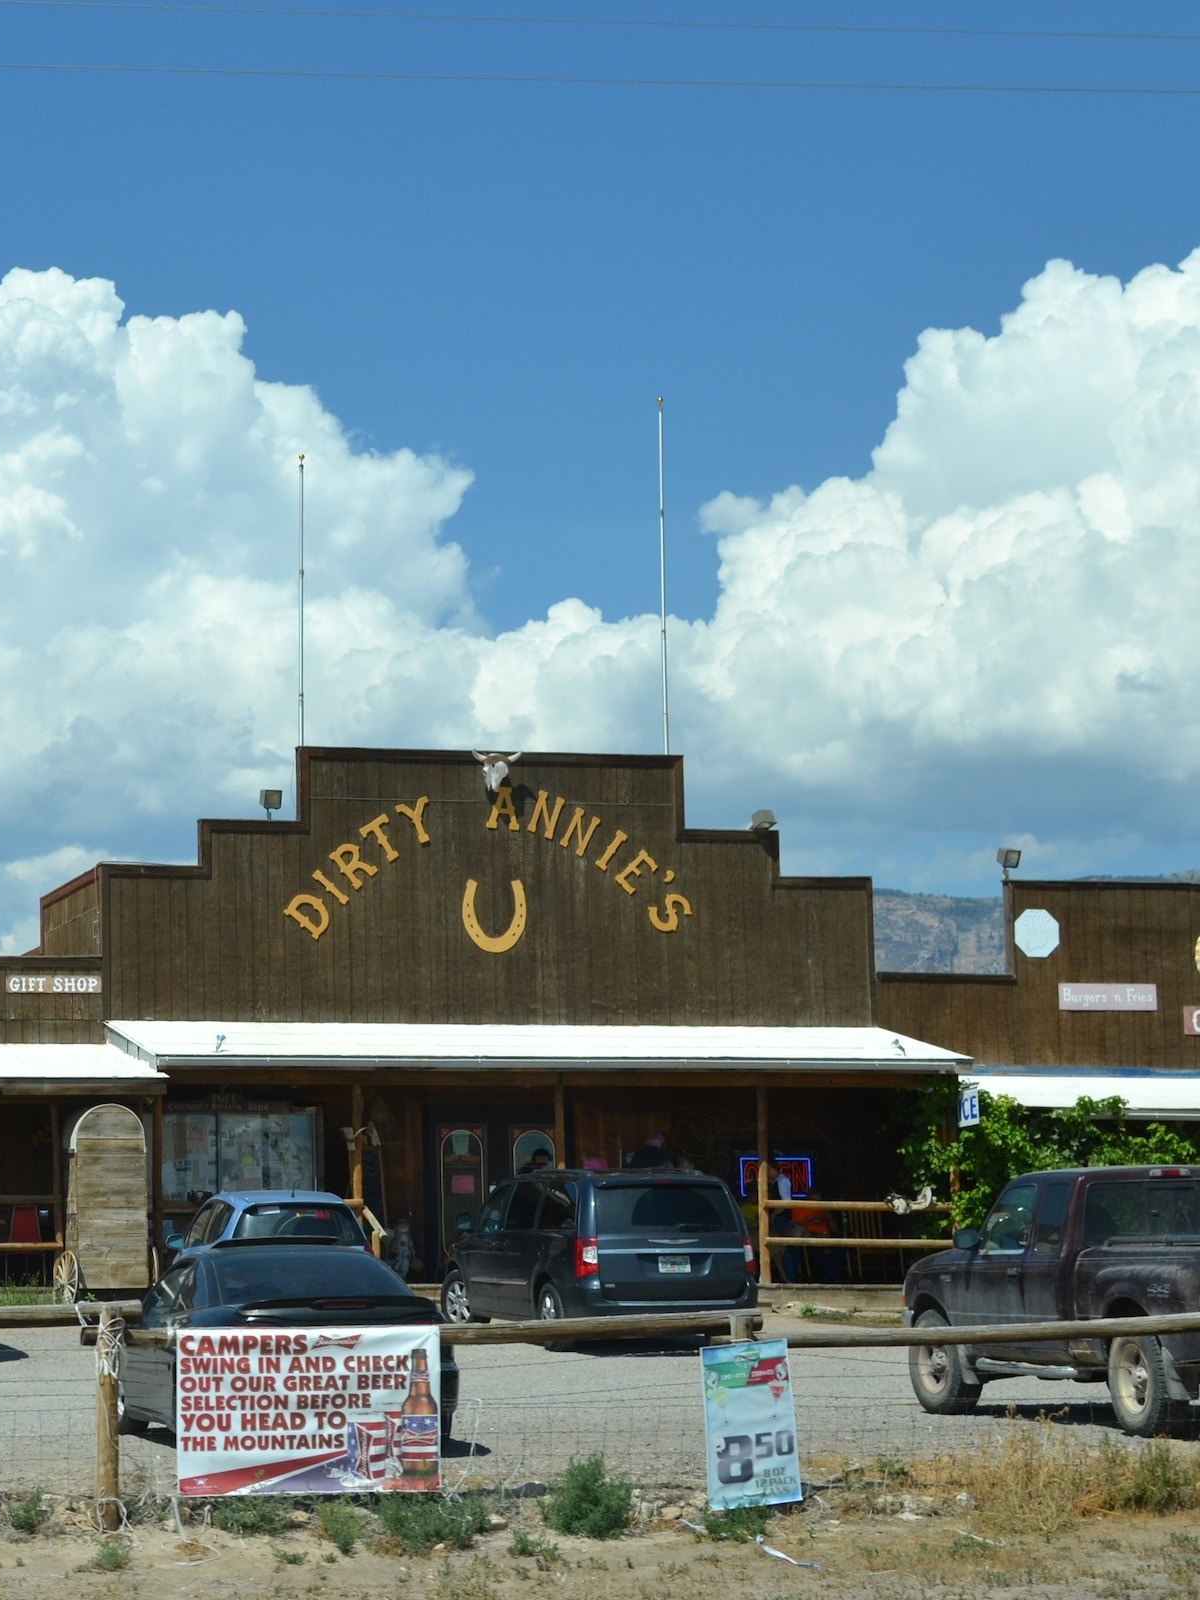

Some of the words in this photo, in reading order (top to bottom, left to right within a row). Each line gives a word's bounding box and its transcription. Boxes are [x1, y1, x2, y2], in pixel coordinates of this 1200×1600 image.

[284, 796, 430, 940] DIRTY
[486, 787, 693, 932] ANNIE'S
[9, 977, 46, 992] GIFT
[52, 977, 98, 992] SHOP
[1063, 988, 1107, 1007] Burgers
[1126, 988, 1152, 1003] Fries
[180, 1335, 308, 1356] CAMPERS
[180, 1357, 250, 1374] SWING
[258, 1356, 281, 1374] IN
[288, 1356, 336, 1373] AND
[343, 1355, 411, 1373] CHECK
[180, 1376, 223, 1393] OUT
[230, 1376, 276, 1393] OUR
[283, 1375, 350, 1392] GREAT
[357, 1374, 407, 1390] BEER
[181, 1395, 288, 1412] SELECTION
[297, 1393, 372, 1410] BEFORE
[181, 1413, 231, 1432] YOU
[241, 1412, 306, 1432] HEAD
[314, 1411, 346, 1430] TO
[181, 1436, 217, 1451] THE
[223, 1433, 345, 1451] MOUNTAINS
[773, 1467, 786, 1476] OZ
[755, 1479, 767, 1488] 12
[769, 1476, 797, 1487] PACK
